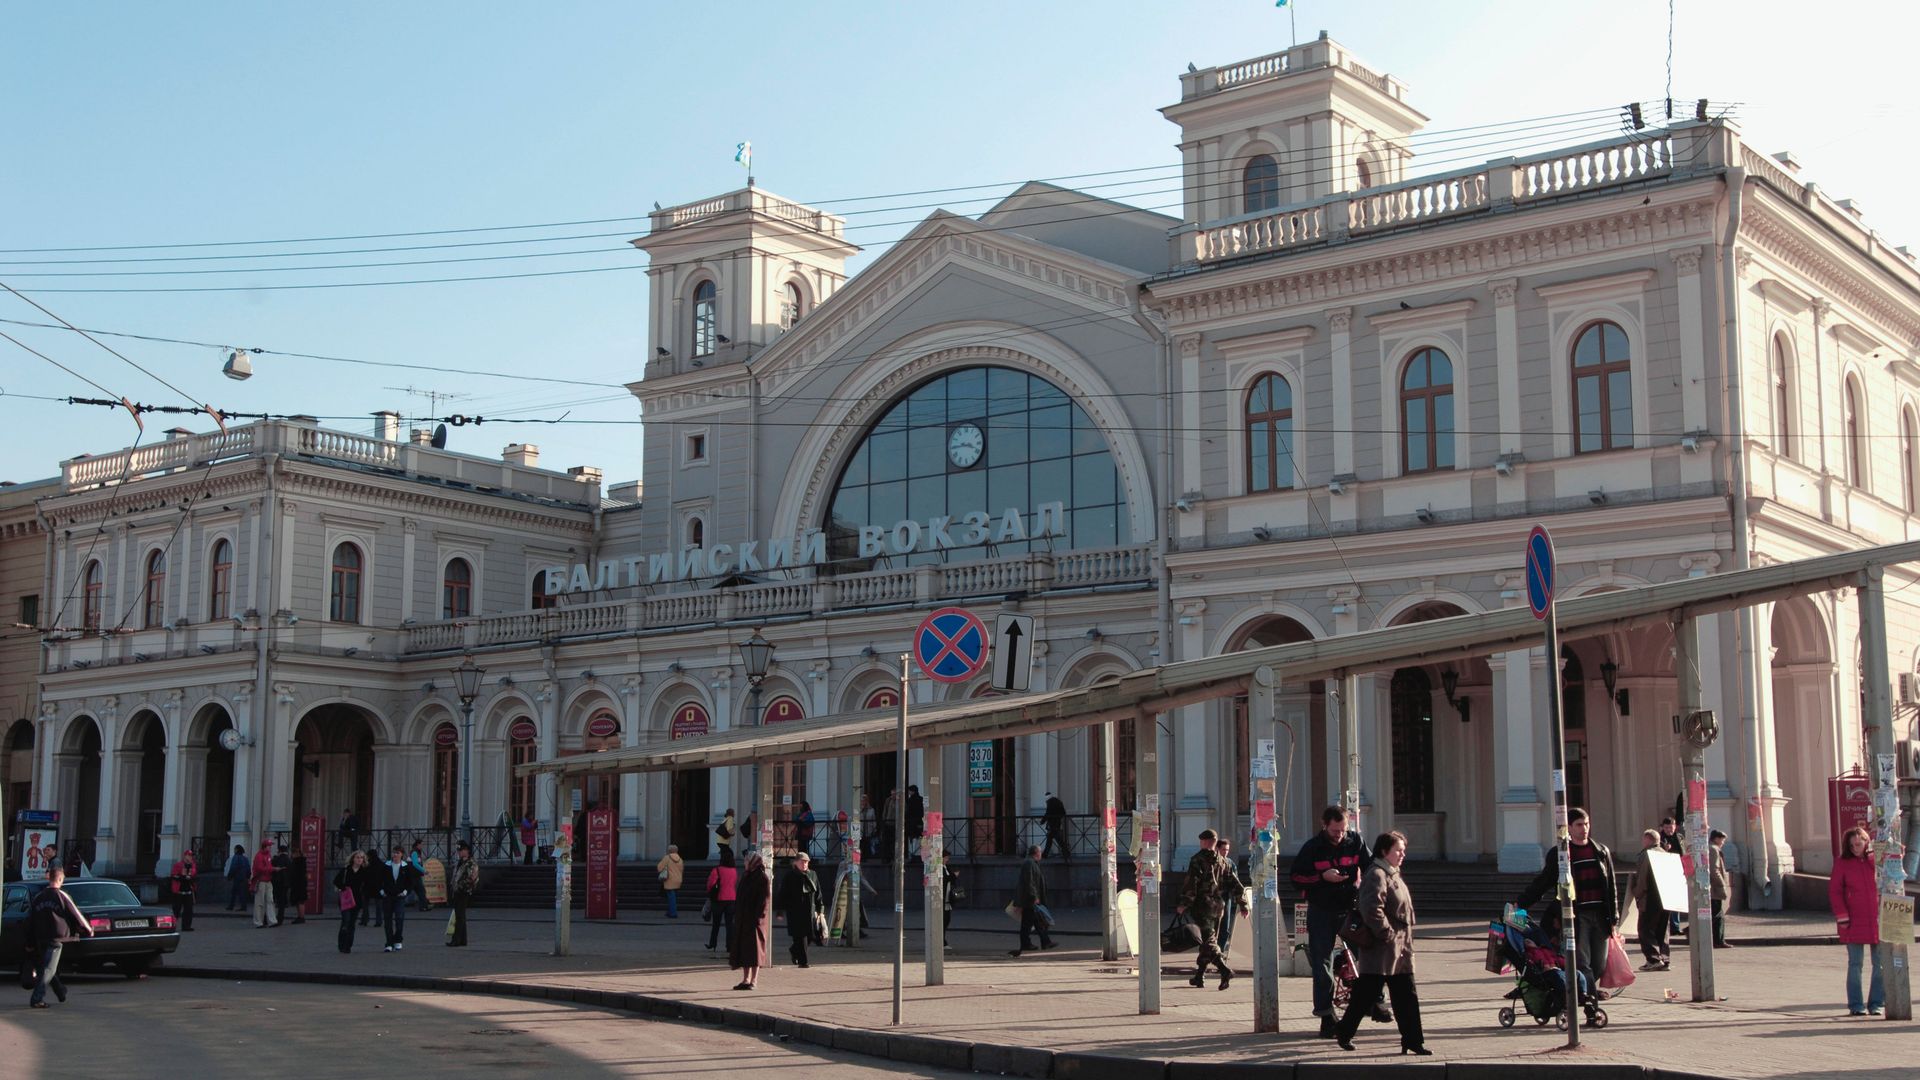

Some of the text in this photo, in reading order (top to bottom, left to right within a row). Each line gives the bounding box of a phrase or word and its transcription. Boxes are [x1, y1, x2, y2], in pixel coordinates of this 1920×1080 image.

[544, 500, 1064, 596] БАЛТИЙСКИЙ ВОКЗАЛ
[1883, 901, 1912, 913] КУРСЫ
